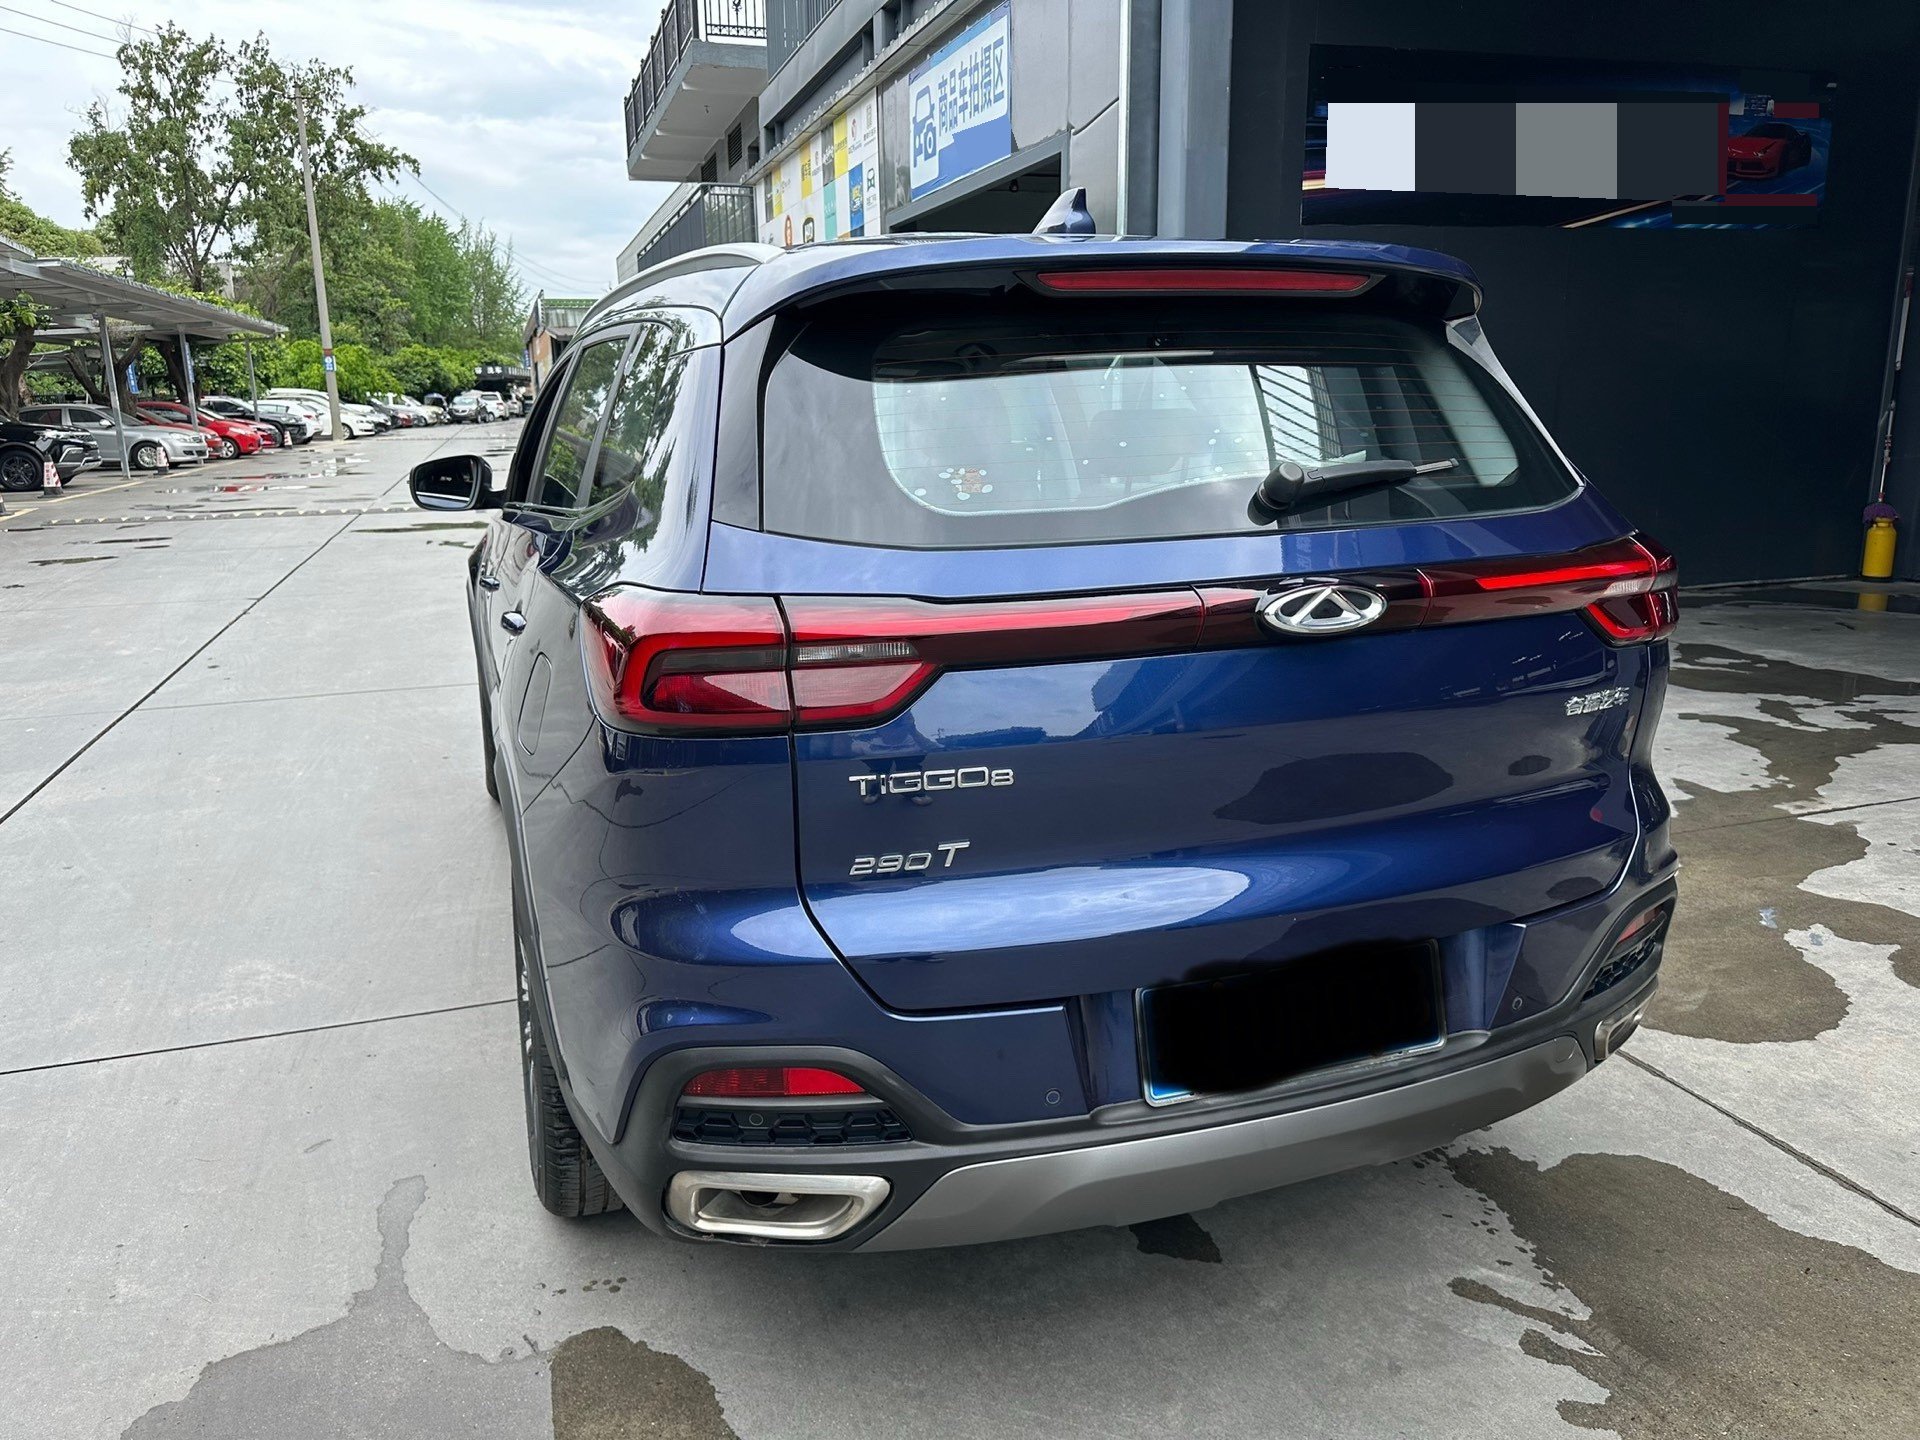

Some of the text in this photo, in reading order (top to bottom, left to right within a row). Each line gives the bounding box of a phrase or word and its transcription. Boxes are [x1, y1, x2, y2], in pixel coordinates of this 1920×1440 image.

[938, 37, 1004, 136] 商品车拍摄区
